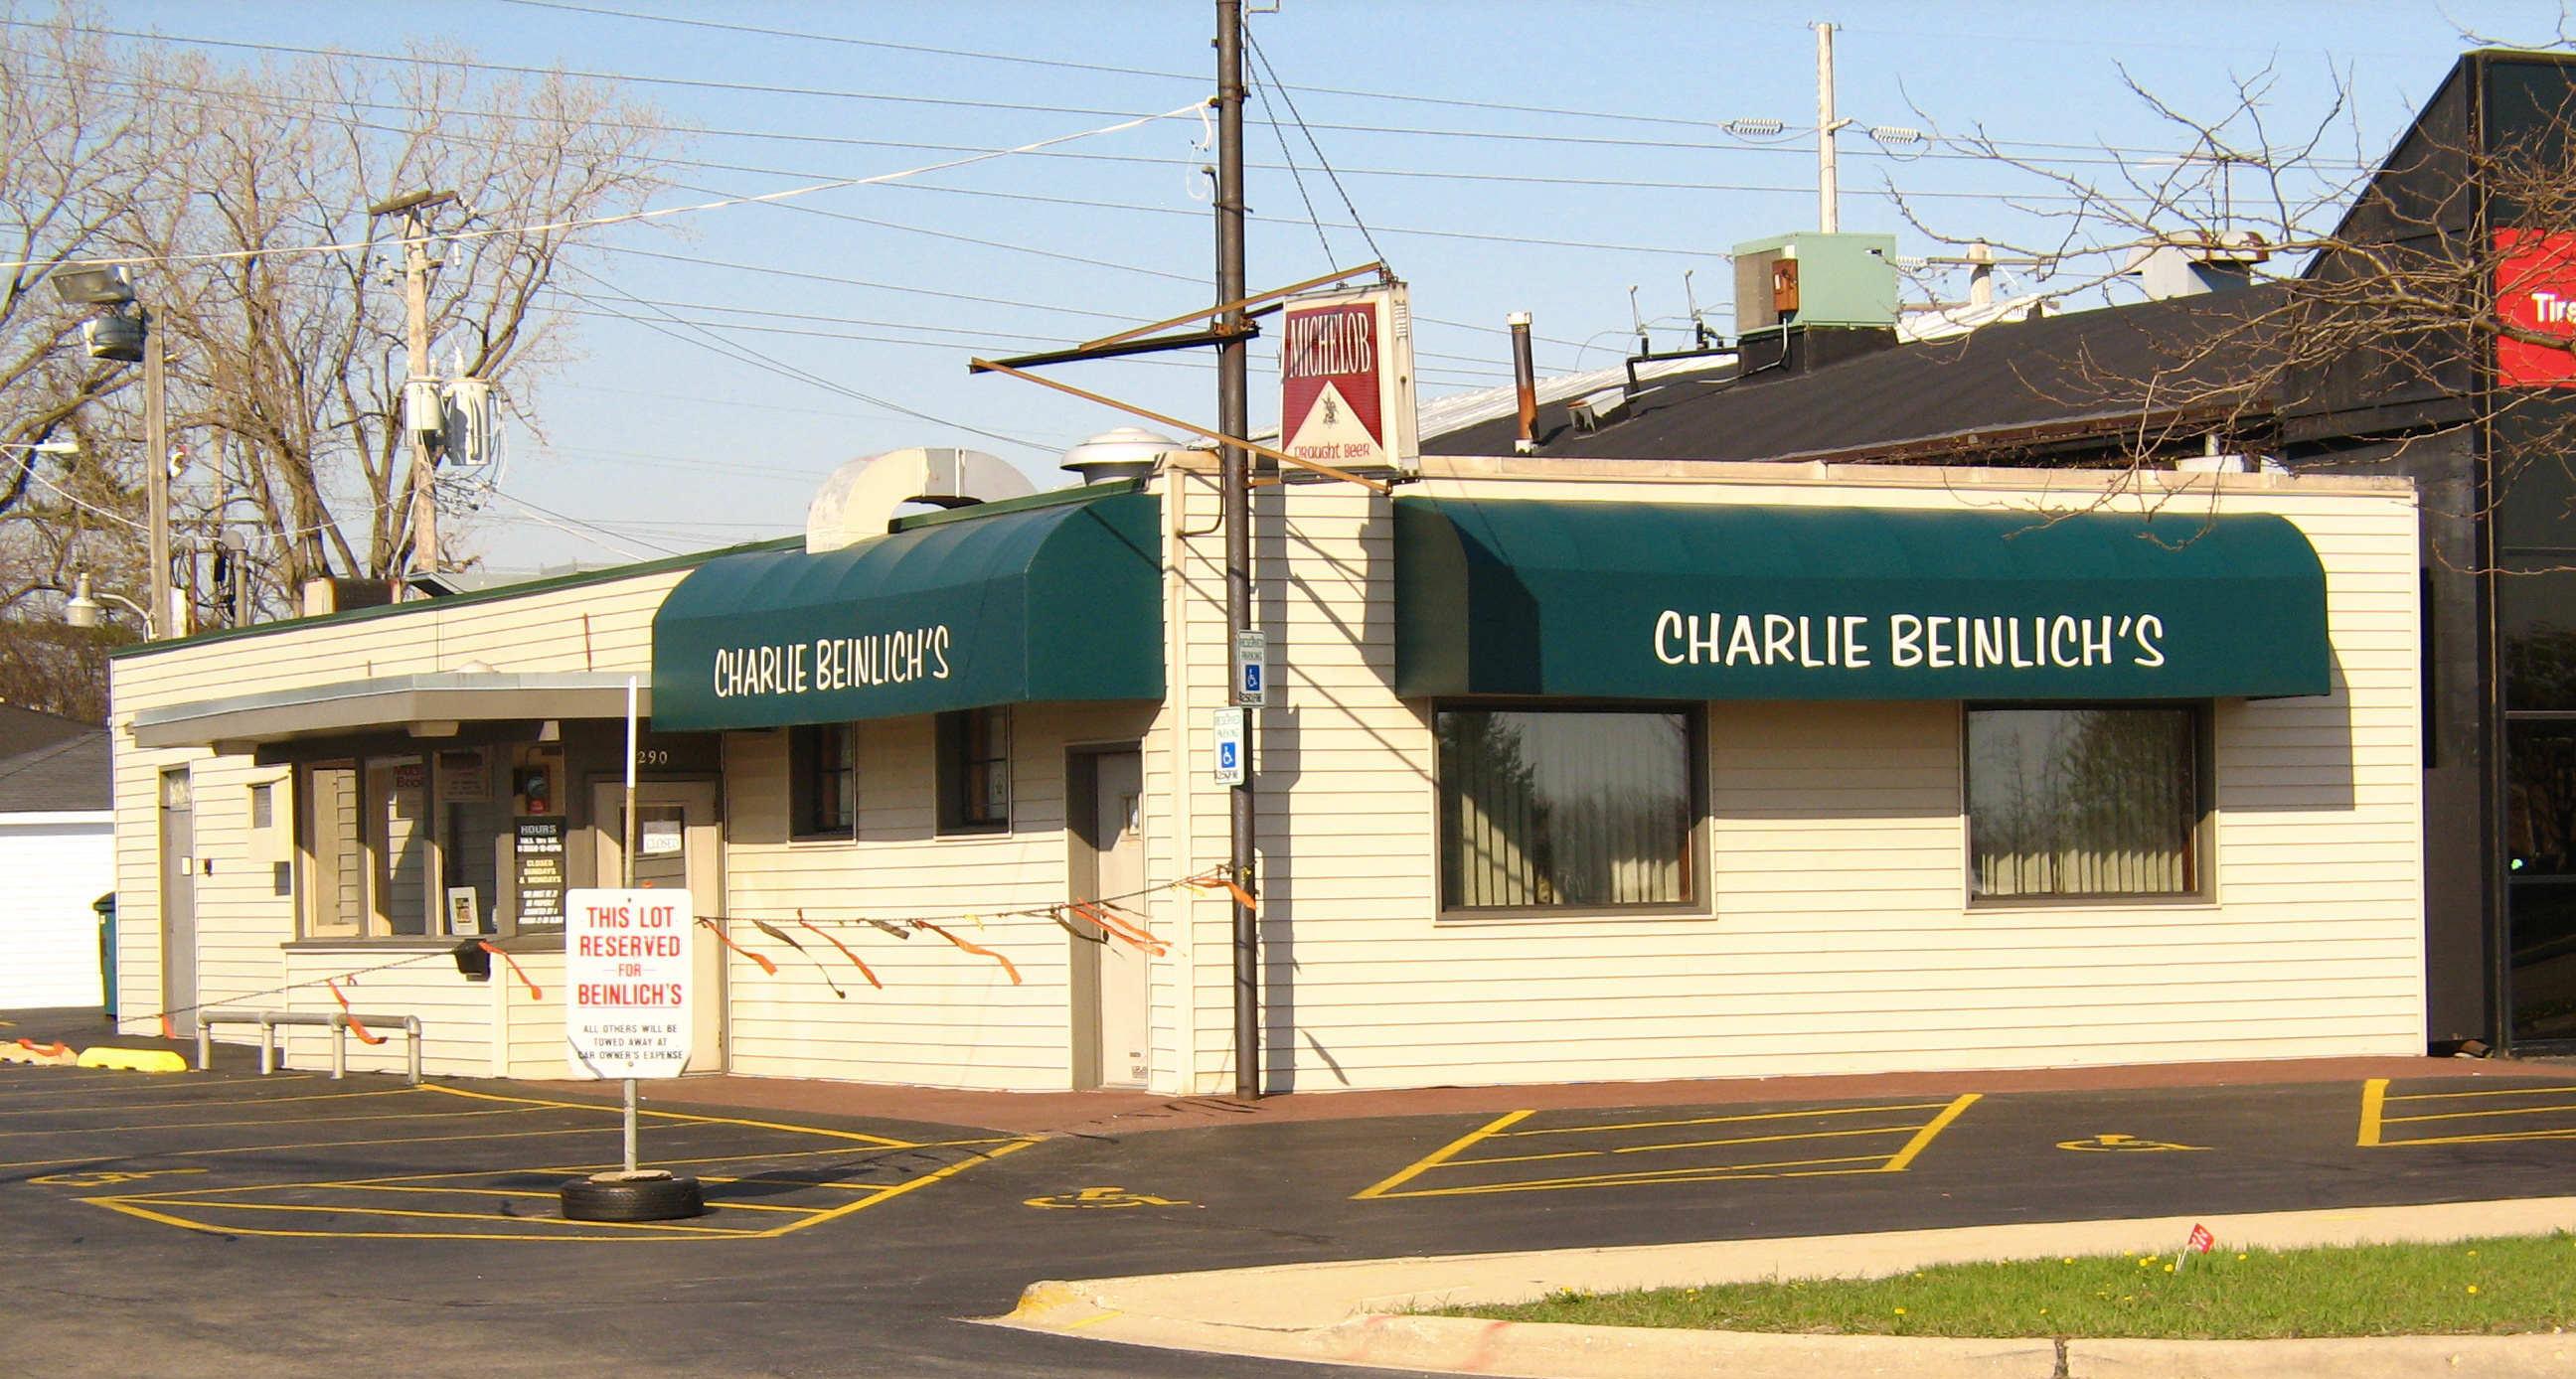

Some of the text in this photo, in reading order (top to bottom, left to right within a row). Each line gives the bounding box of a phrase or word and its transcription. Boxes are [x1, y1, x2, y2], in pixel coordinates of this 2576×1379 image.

[1289, 311, 1371, 379] MICHELOB
[1654, 609, 2166, 669] CHARLIE BEINLICH'S
[715, 624, 949, 698] CHARLIE BEINLICH'S
[637, 750, 668, 764] 290
[520, 825, 558, 836] HOURS
[586, 906, 630, 928] THIS
[639, 906, 674, 928] LOT
[579, 935, 681, 957] RESERVED
[618, 963, 642, 978] FOR
[577, 984, 683, 1005] BEINLICH'S
[667, 1024, 678, 1033] BE
[599, 1051, 640, 1060] OWNER'S
